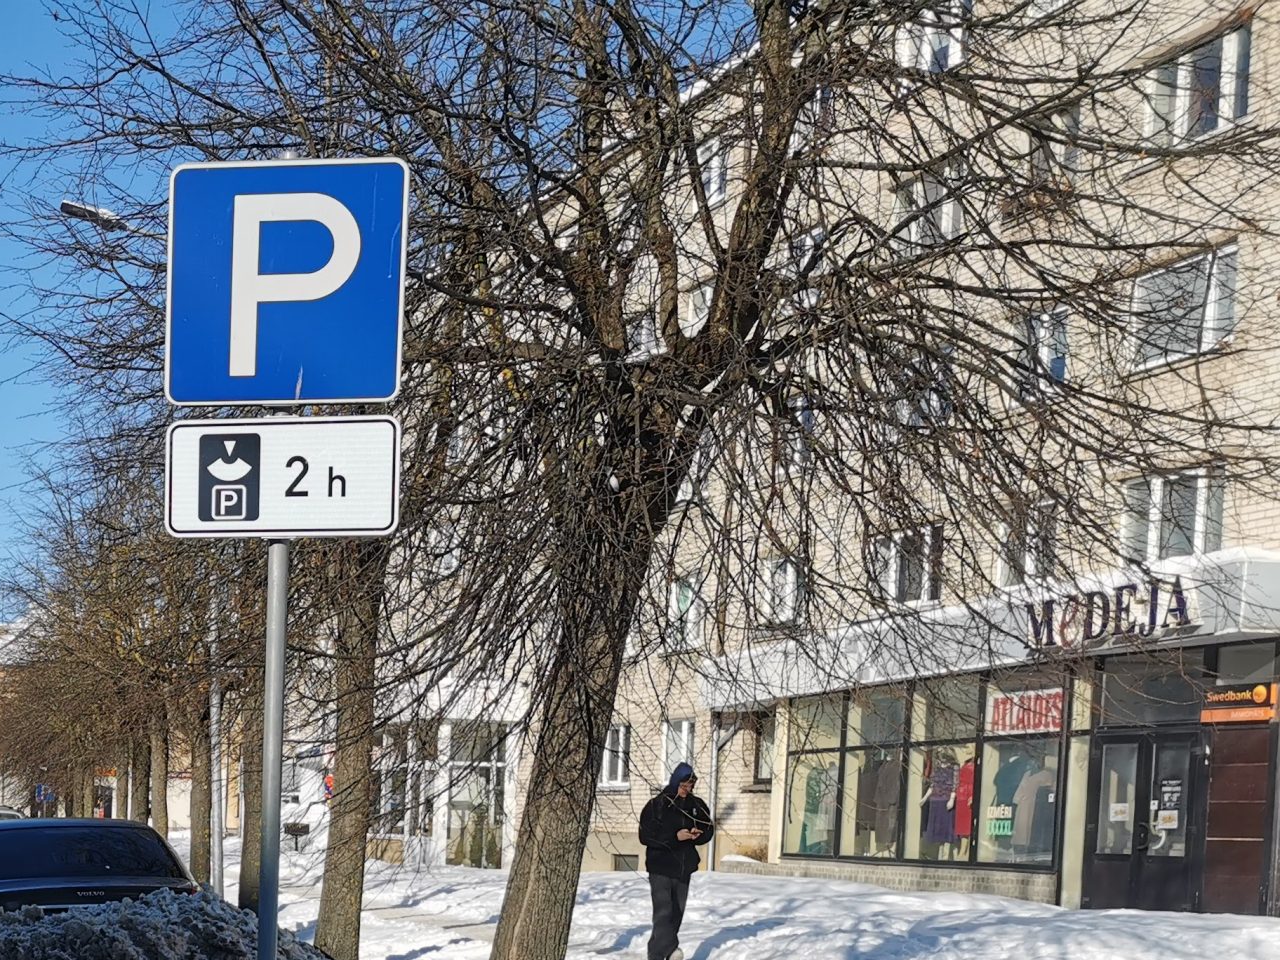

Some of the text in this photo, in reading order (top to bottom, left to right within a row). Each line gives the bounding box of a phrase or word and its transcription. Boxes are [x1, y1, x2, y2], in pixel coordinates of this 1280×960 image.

[229, 192, 361, 377] P
[285, 455, 346, 497] 2 h
[220, 490, 238, 515] P
[1207, 689, 1252, 702] Swedbank
